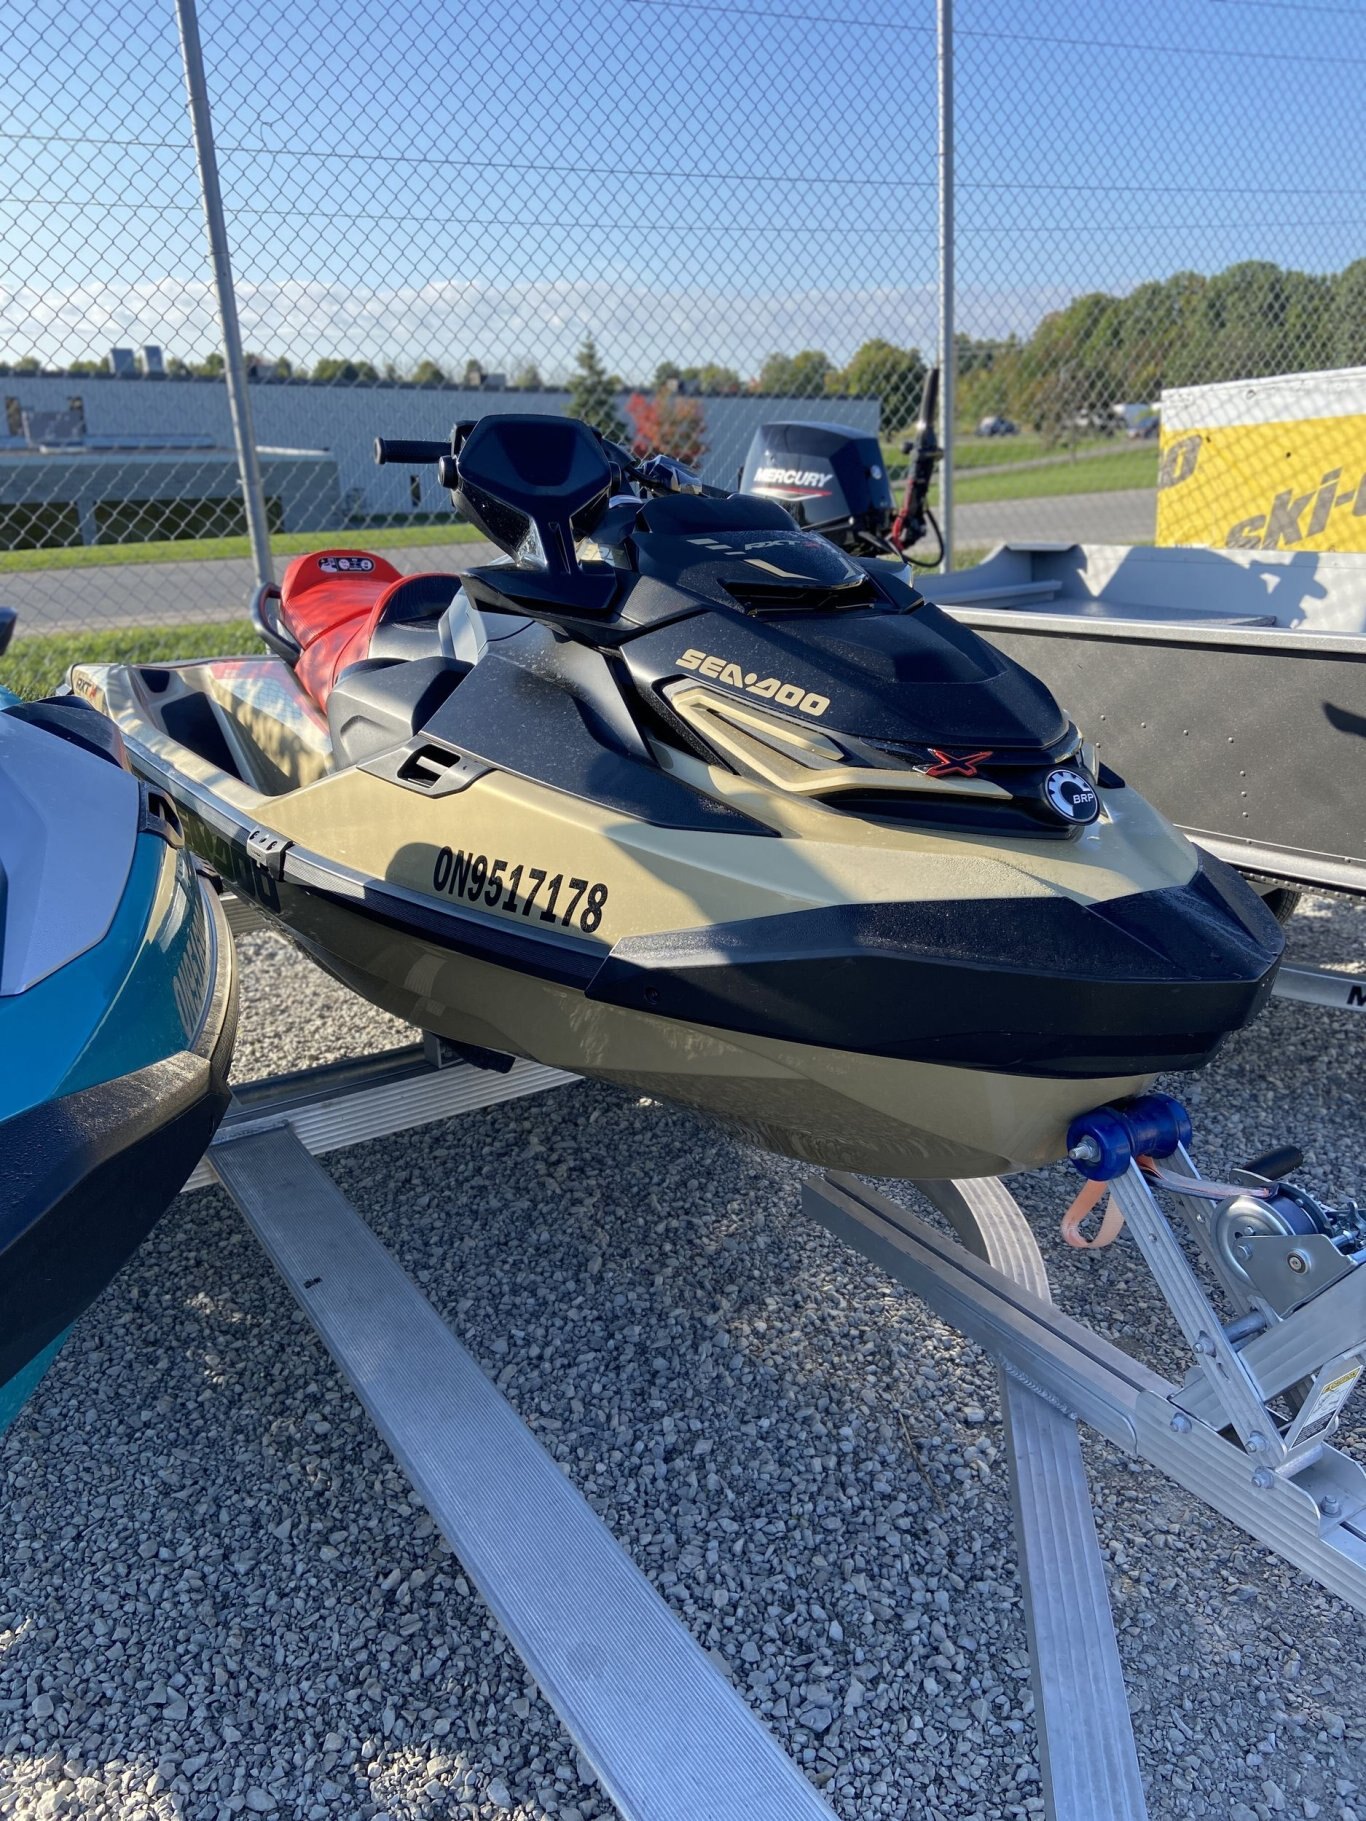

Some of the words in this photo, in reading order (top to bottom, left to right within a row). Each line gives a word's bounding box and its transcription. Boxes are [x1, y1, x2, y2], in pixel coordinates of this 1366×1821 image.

[753, 467, 834, 488] MERCURY
[1073, 793, 1094, 804] BRP
[433, 845, 609, 934] ON9517178
